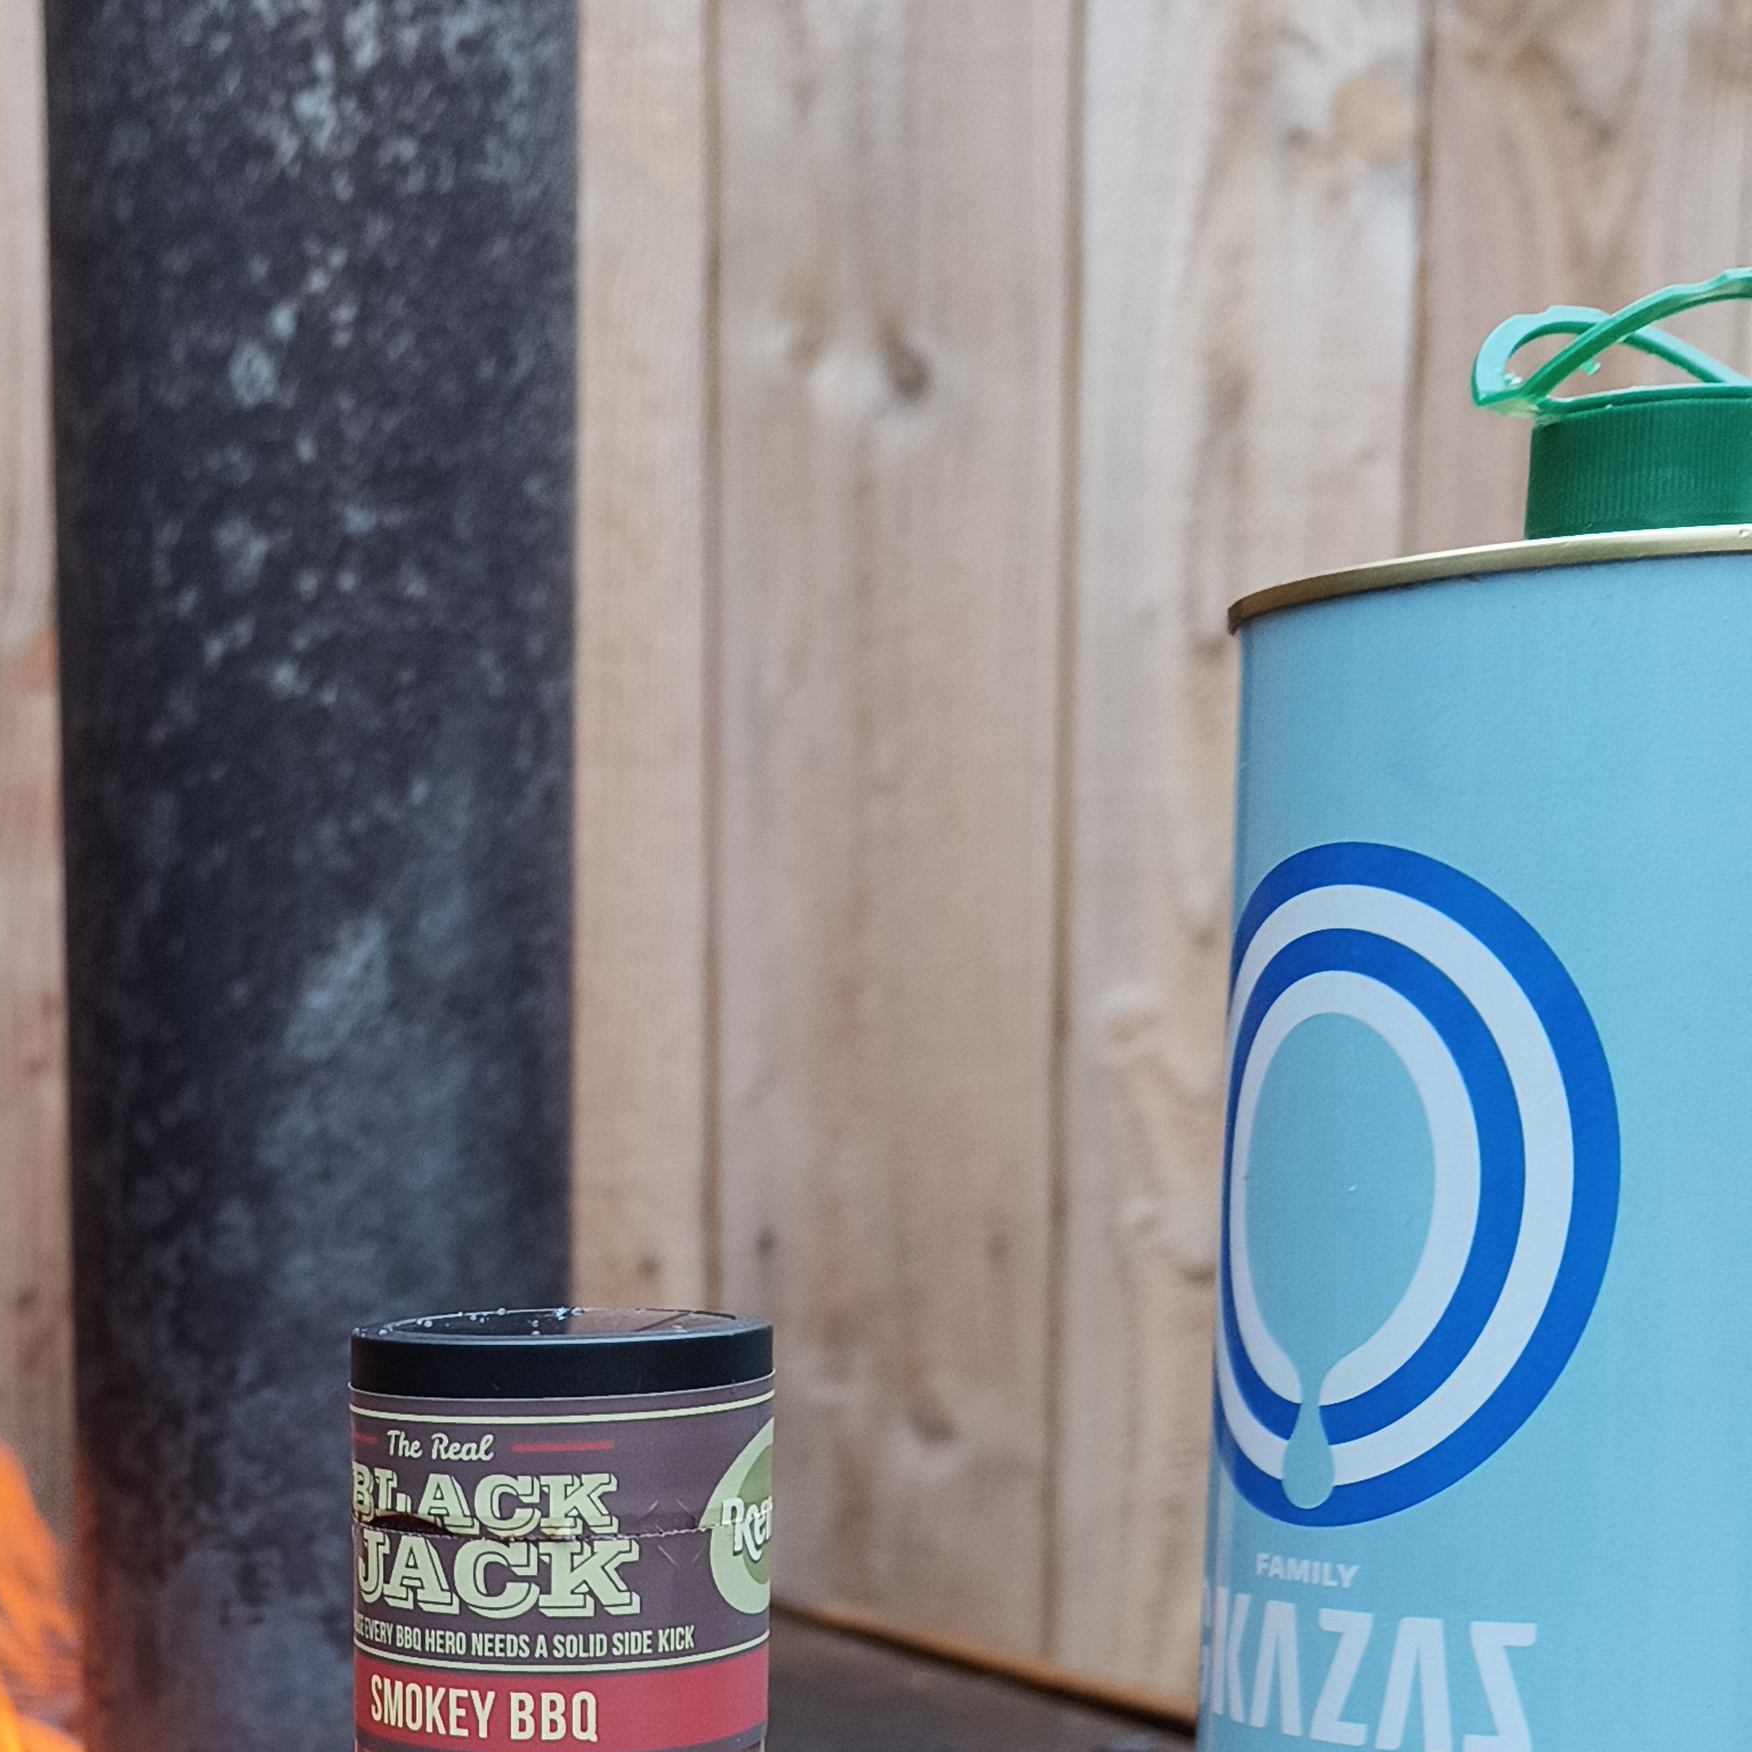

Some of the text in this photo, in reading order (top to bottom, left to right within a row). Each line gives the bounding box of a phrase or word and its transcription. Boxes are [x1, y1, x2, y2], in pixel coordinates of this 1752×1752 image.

[387, 1430, 494, 1461] The Real
[352, 1461, 618, 1537] BLACK
[722, 1496, 772, 1564] Re
[358, 1528, 640, 1619] JACK
[1255, 1552, 1360, 1588] FAMILY
[364, 1616, 394, 1646] EVERY
[396, 1625, 421, 1651] BBQ
[425, 1629, 466, 1656] HERO
[471, 1632, 530, 1658] NEEDS
[534, 1634, 548, 1658] A
[553, 1633, 608, 1658] SOLID
[612, 1630, 653, 1656] SIDE
[658, 1624, 695, 1653] KICK
[370, 1674, 599, 1742] SMOKEY BBQ
